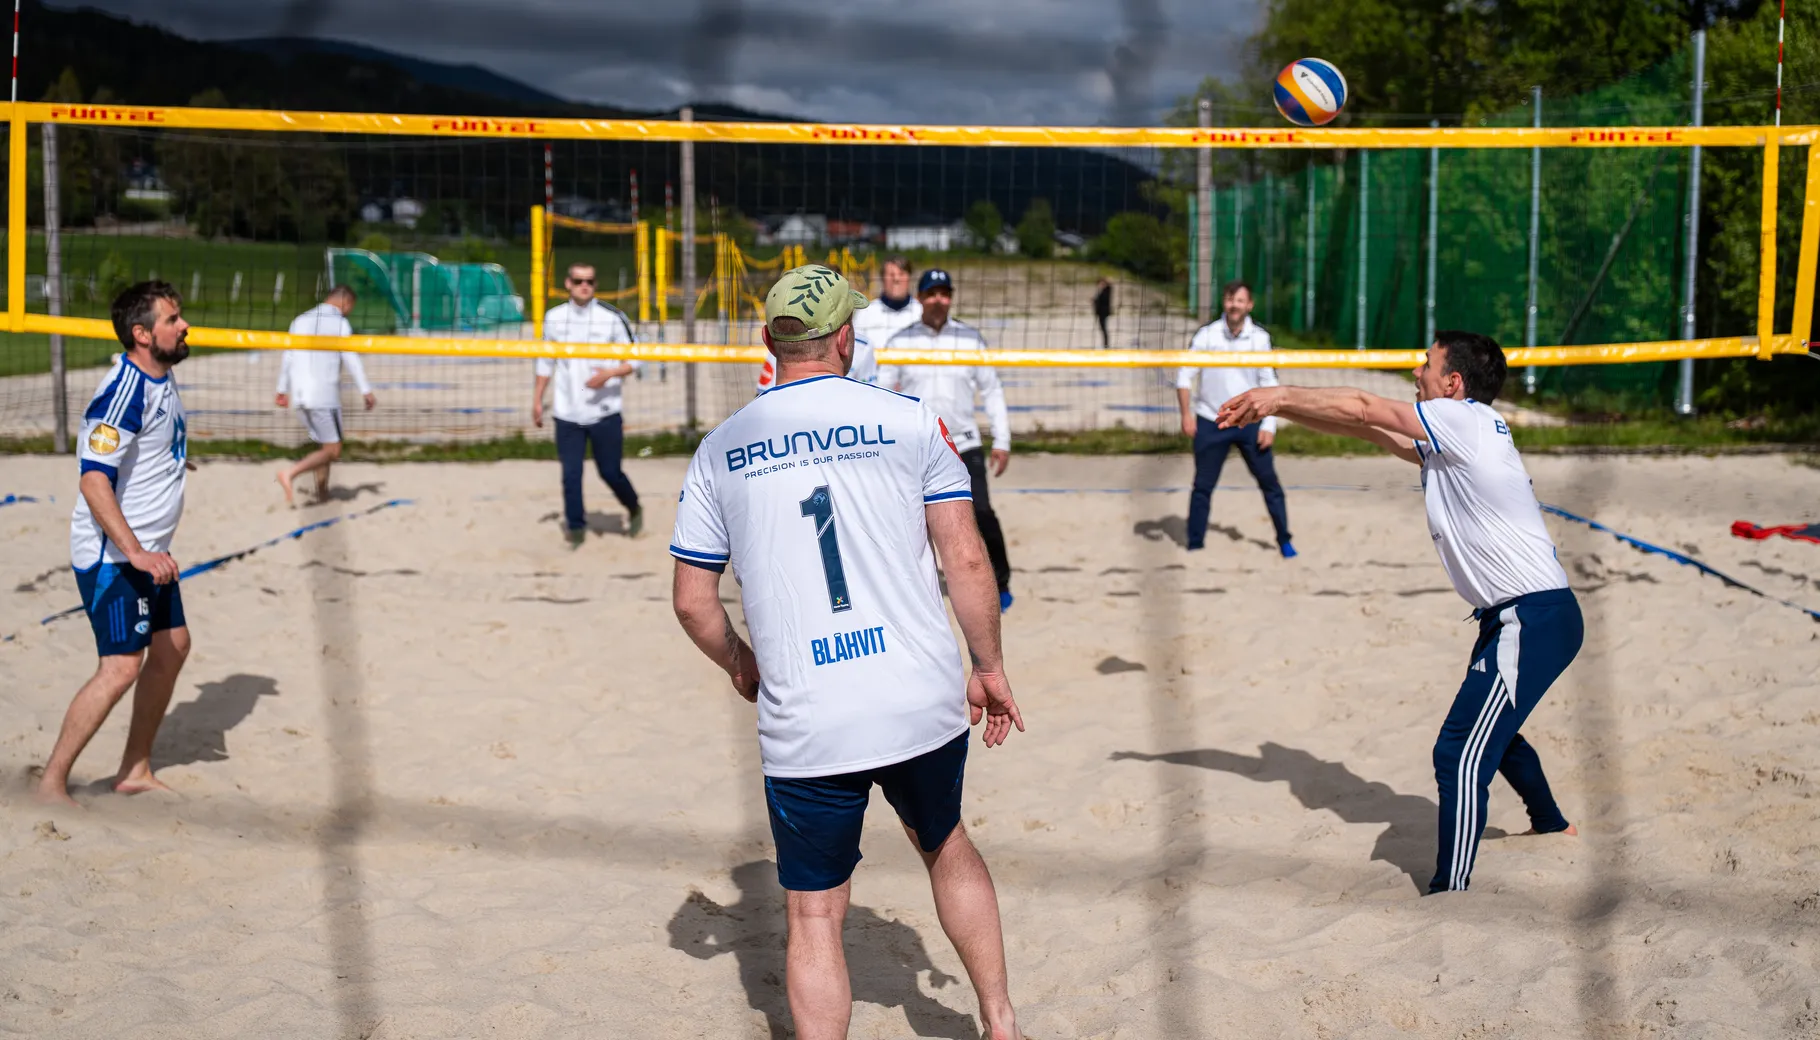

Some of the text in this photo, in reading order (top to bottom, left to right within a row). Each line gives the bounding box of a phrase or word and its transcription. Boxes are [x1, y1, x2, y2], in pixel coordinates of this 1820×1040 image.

[51, 105, 165, 122] FUNTEC
[432, 118, 545, 134] FUNTEC
[1191, 129, 1304, 143] FUNTEC
[1571, 129, 1682, 143] FUNTEC
[726, 424, 896, 472] BRUNVOLL
[744, 461, 796, 480] PRECISION
[813, 455, 833, 465] OUR
[837, 450, 880, 462] PASSION
[799, 484, 853, 614] 1
[137, 597, 149, 616] 15
[811, 626, 886, 666] BLÅHVIT
